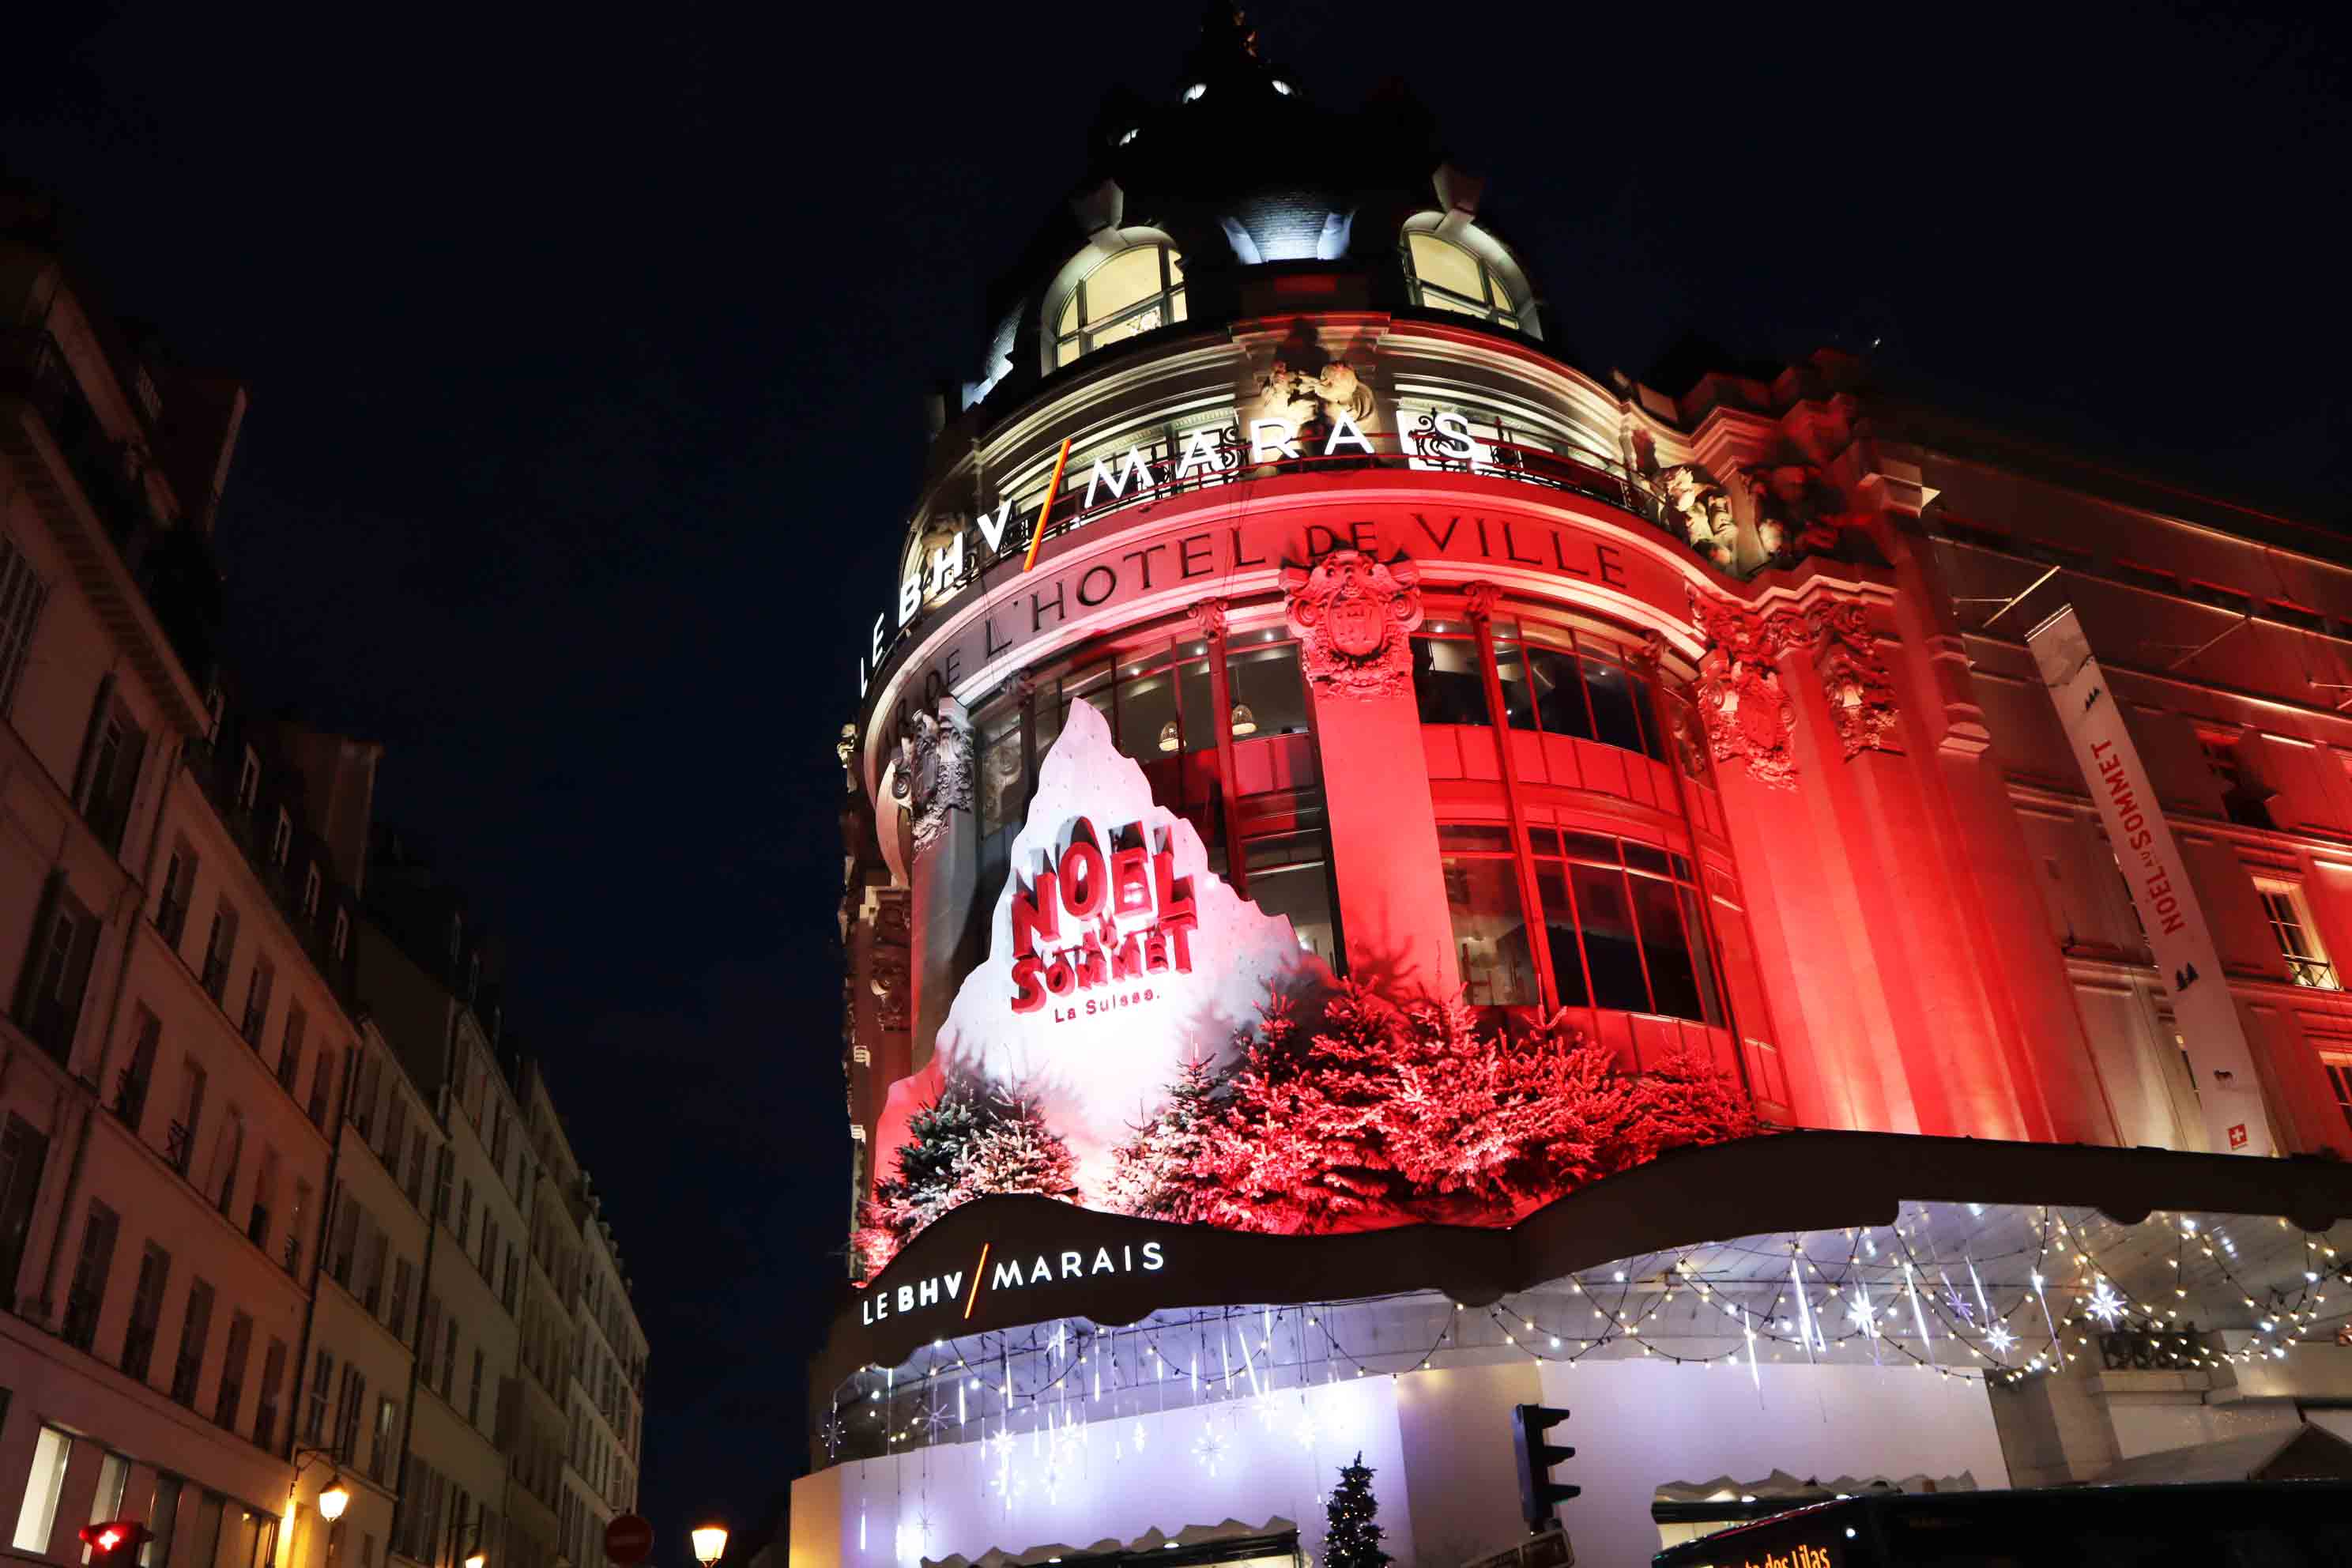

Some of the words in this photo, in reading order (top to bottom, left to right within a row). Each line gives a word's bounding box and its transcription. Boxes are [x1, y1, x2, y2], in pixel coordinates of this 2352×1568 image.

[861, 612, 884, 699] LE
[899, 499, 1013, 627] BHV
[1084, 410, 1479, 508] MARAIS
[986, 527, 1265, 659] L'HOTEL
[1305, 521, 1378, 558] DE
[1414, 513, 1627, 590] VILLE
[2090, 740, 2151, 850] SOMMET
[1011, 917, 1197, 1013] SOMMET
[1054, 1008, 1076, 1023] La
[863, 1292, 888, 1325] LE
[898, 1272, 962, 1313] BHV
[993, 1242, 1164, 1291] MARAIS
[1791, 1544, 1831, 1568] Lilas
